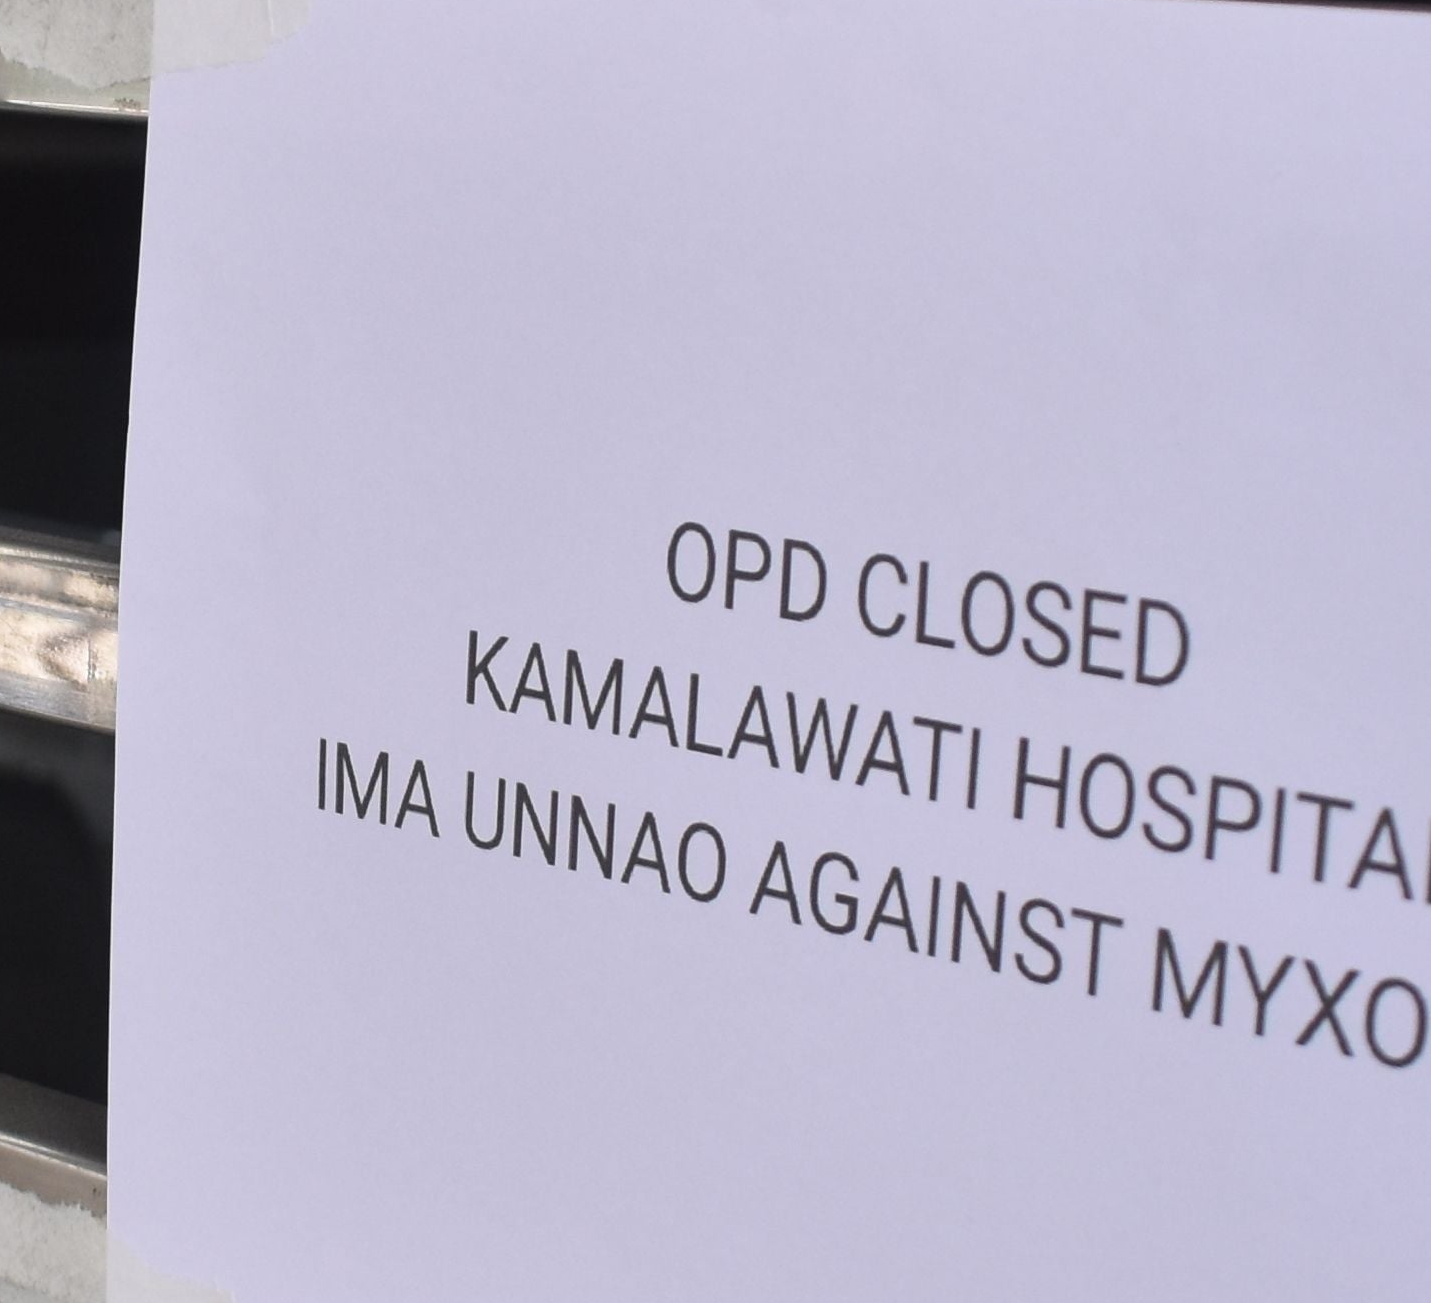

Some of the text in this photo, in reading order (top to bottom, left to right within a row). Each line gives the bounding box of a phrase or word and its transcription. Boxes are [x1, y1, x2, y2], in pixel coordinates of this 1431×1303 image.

[667, 521, 1190, 687] OPD CLOSED
[466, 630, 981, 810] KAMALAWATI
[318, 738, 440, 838] IMA
[465, 770, 727, 903] UNNAO
[749, 840, 1124, 997] AGAINST
